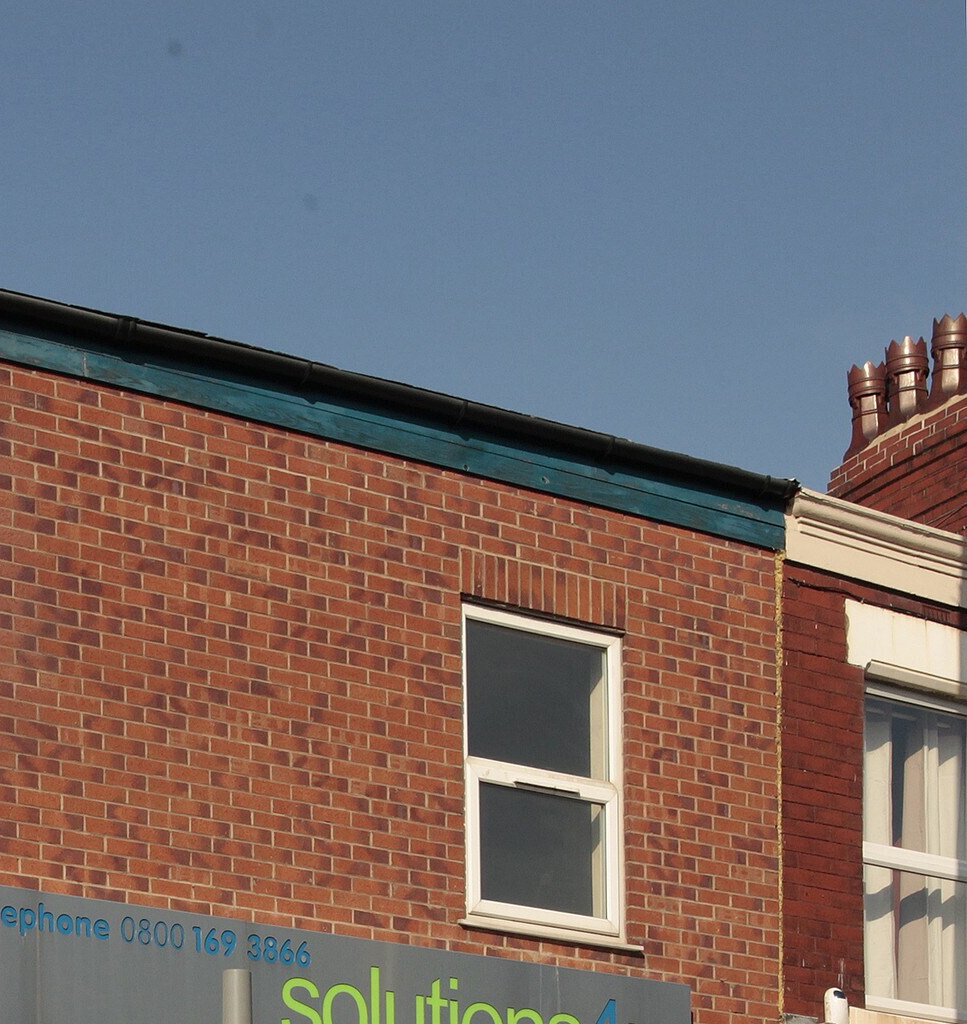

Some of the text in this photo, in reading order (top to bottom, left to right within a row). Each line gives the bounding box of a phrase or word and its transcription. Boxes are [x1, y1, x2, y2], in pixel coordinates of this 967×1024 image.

[121, 916, 184, 949] 0800
[192, 926, 237, 958] 169
[247, 933, 311, 968] 3866
